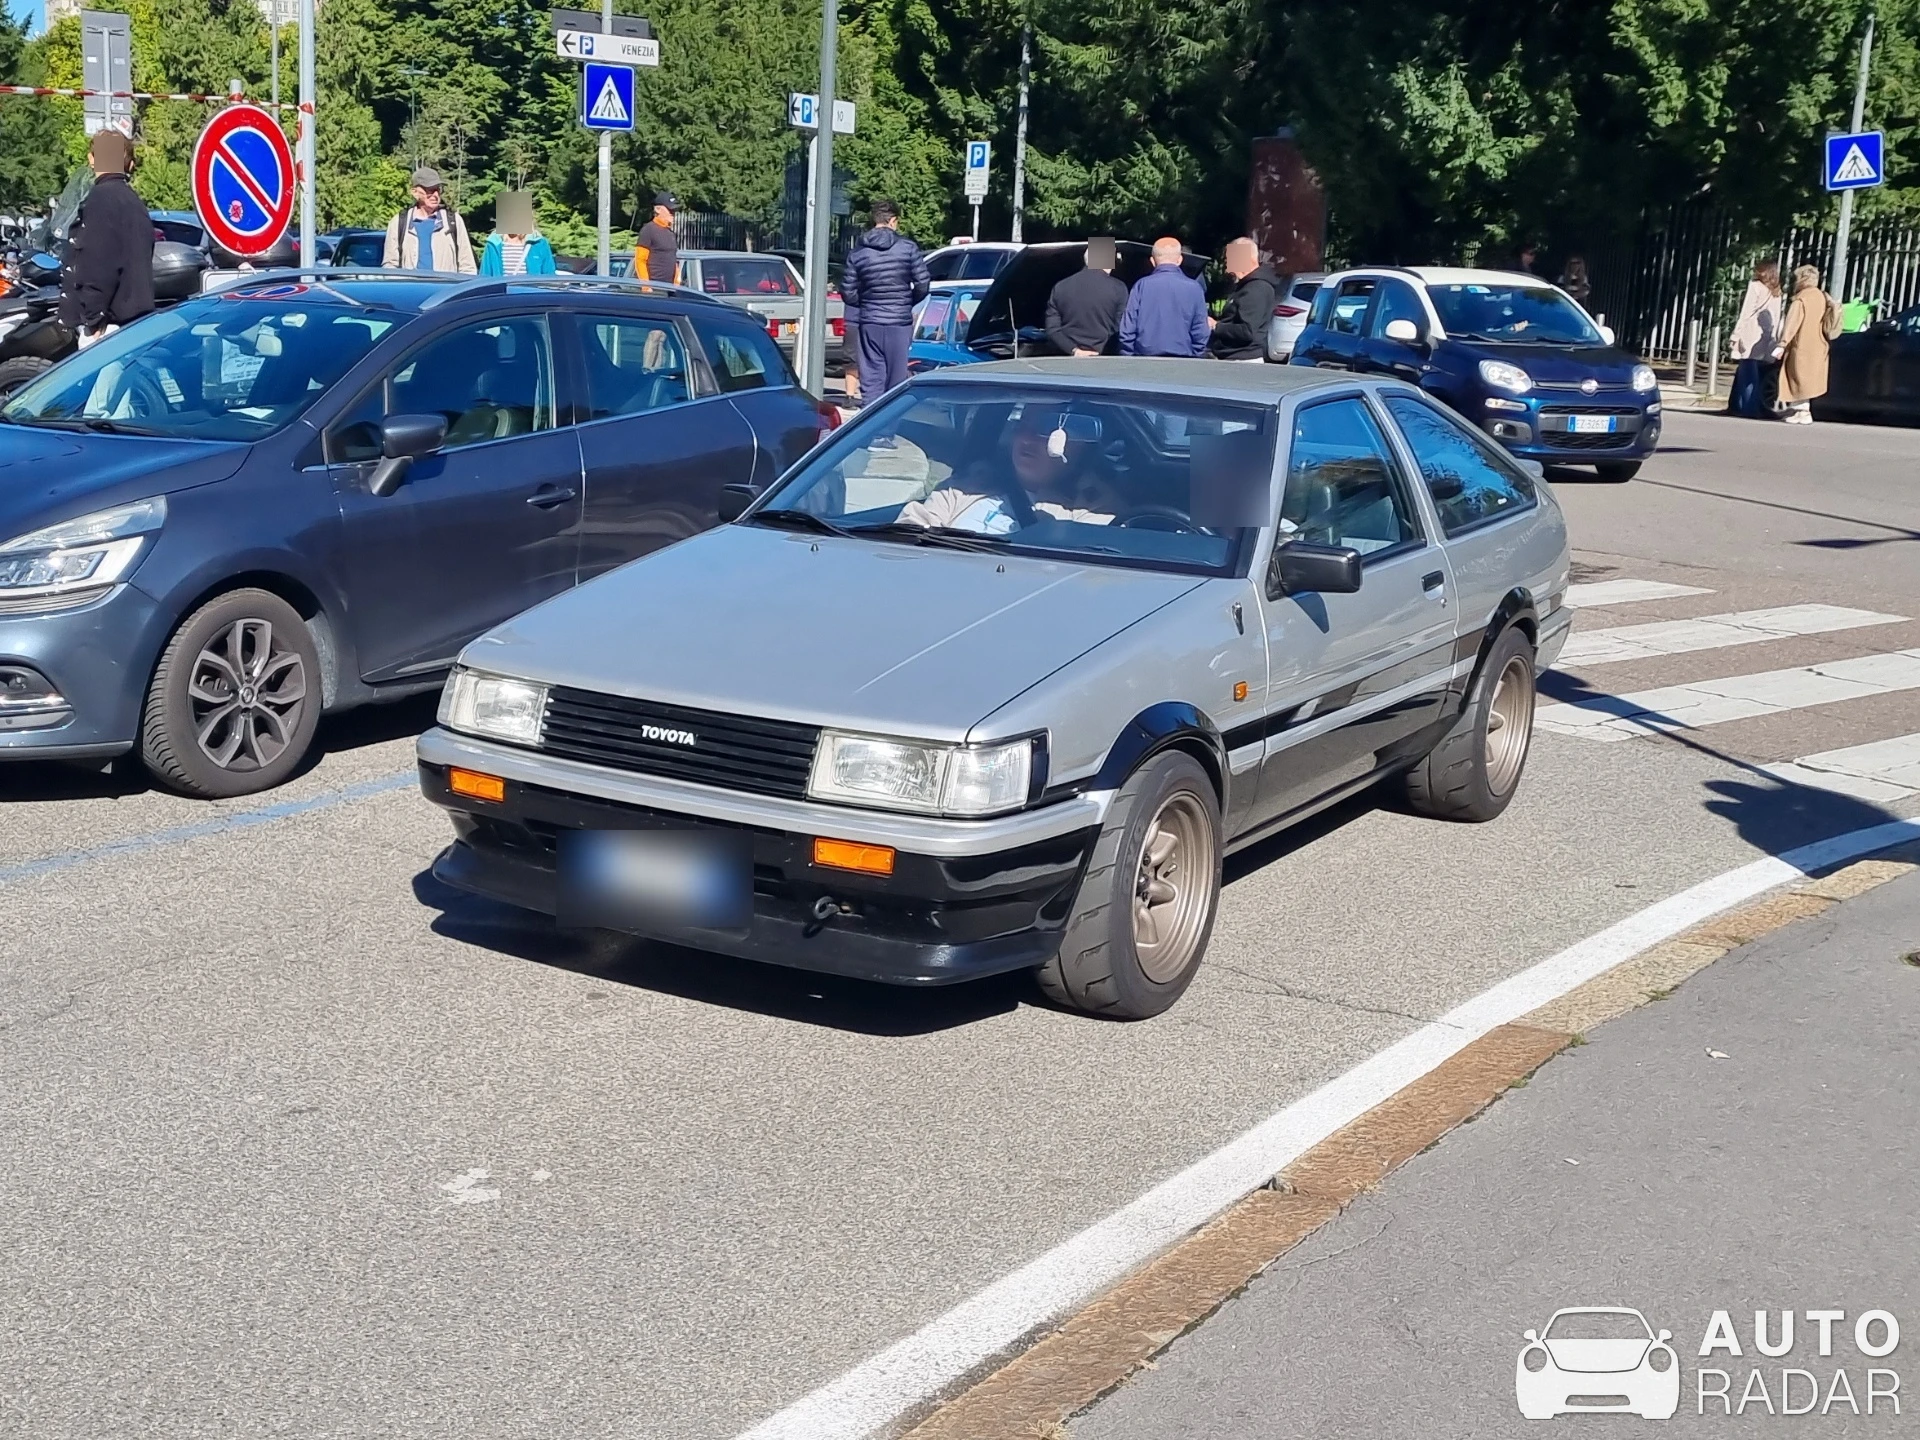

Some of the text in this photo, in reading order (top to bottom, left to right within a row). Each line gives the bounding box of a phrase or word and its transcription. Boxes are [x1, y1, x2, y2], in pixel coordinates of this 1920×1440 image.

[581, 36, 655, 58] P VENEZIA
[803, 100, 811, 121] P
[973, 146, 984, 166] P
[641, 724, 694, 746] TOYOTA
